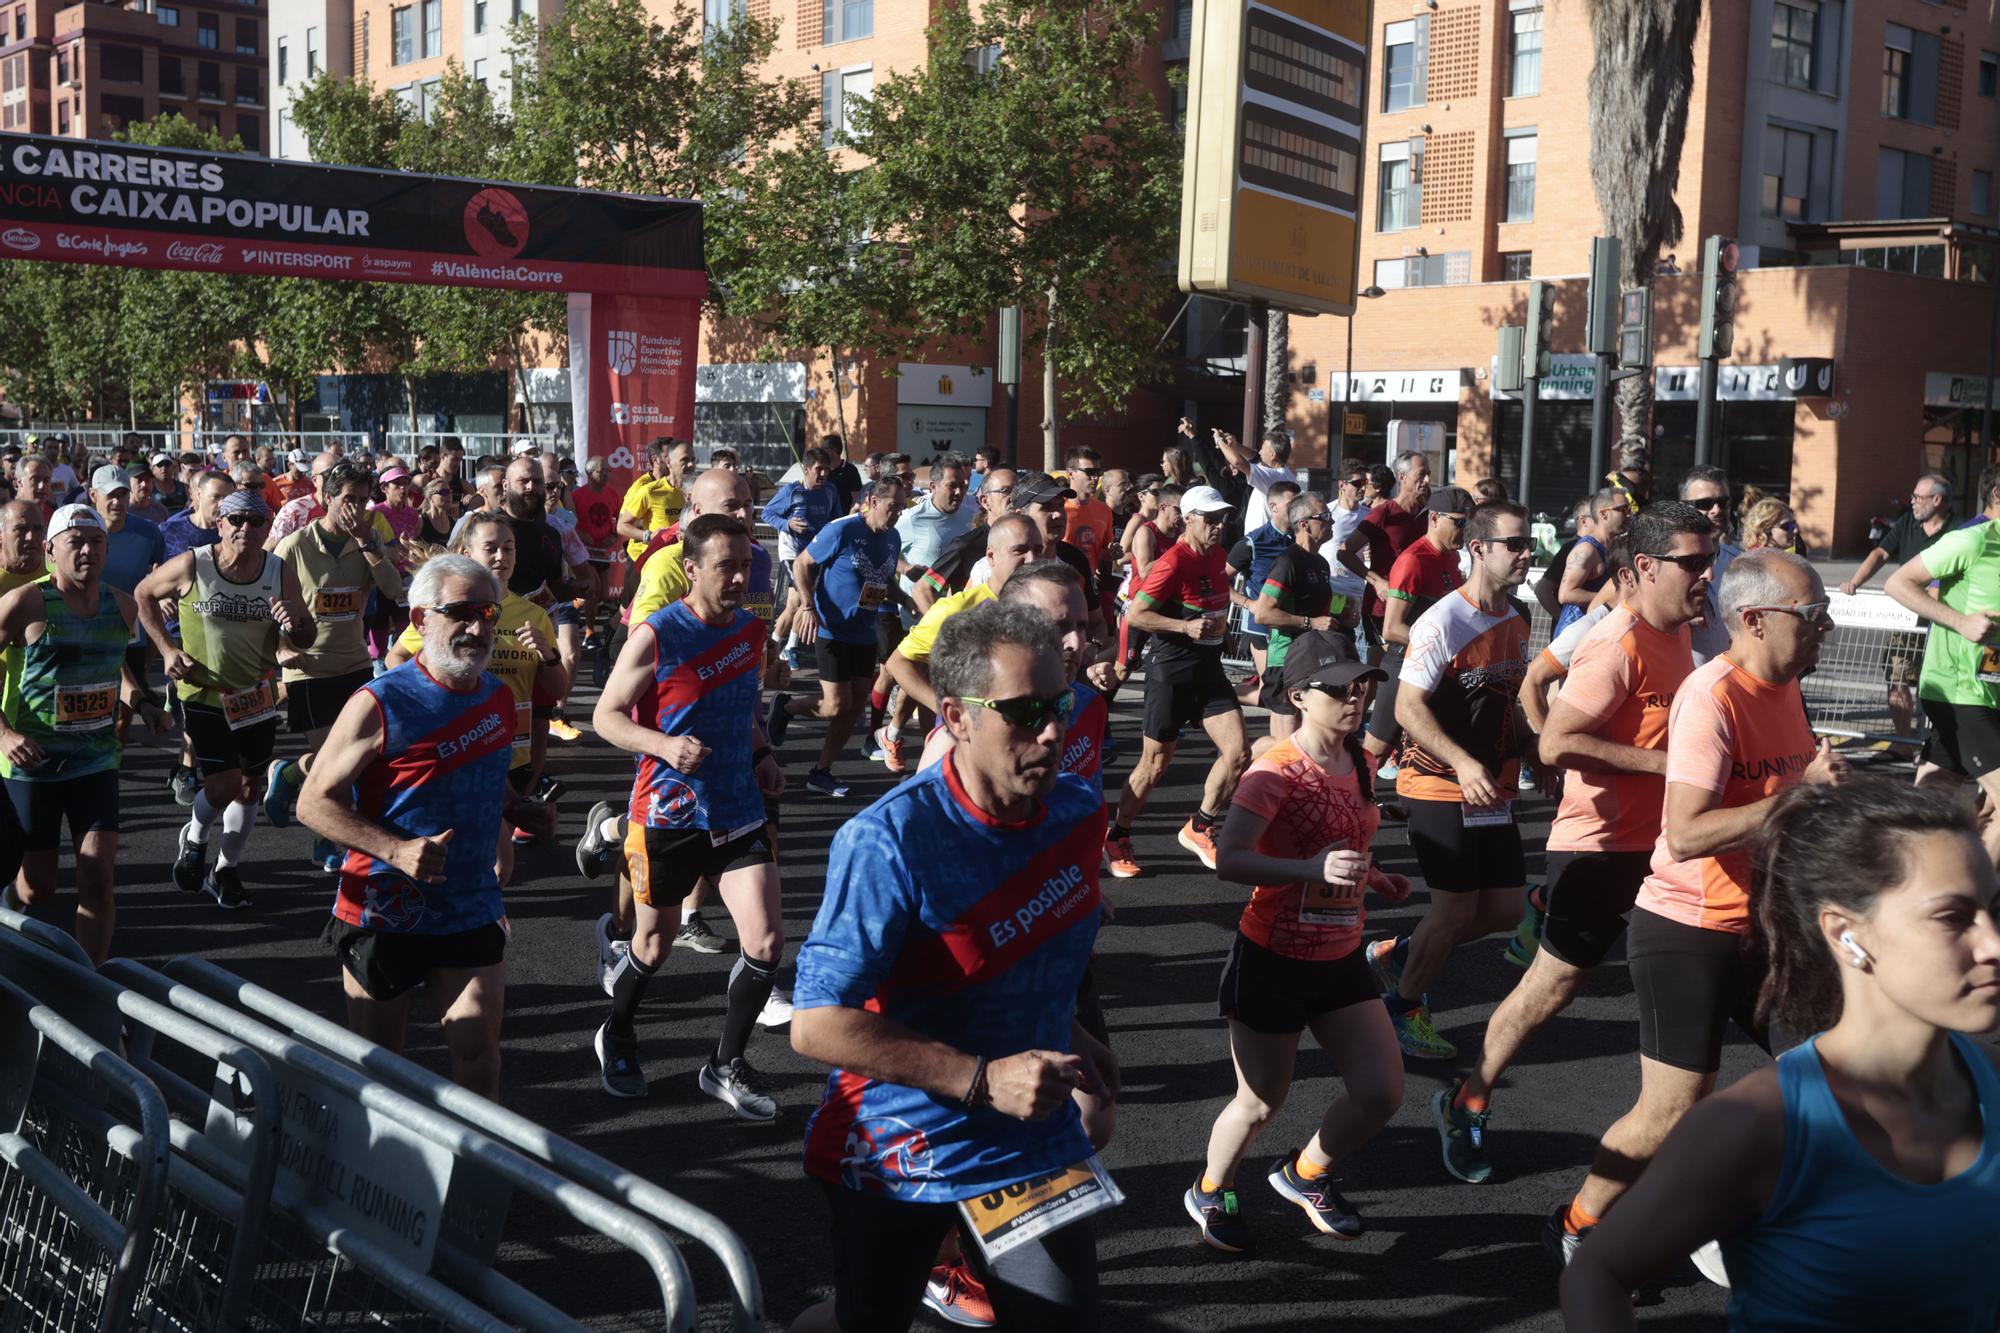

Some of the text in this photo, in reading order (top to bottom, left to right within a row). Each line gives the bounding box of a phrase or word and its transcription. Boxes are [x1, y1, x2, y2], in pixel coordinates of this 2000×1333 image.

[12, 144, 225, 192] CARRERES
[70, 184, 198, 223] CAIXA
[202, 197, 370, 237] POPULAR
[258, 250, 354, 270] INTERSPORT
[373, 258, 411, 270] aspaym
[431, 261, 564, 284] #ValènciaCorre
[640, 335, 681, 346] Fundació
[640, 346, 682, 356] Esportiva
[640, 356, 682, 366] Municipal
[1553, 363, 1596, 378] Urban
[1538, 377, 1594, 394] unning
[632, 404, 659, 415] caixa
[632, 413, 675, 425] popular
[323, 593, 352, 608] 3721
[697, 641, 752, 680] Es posible
[64, 692, 108, 713] 3525
[437, 713, 502, 759] Es posible
[988, 864, 1084, 949] Es posible
[1051, 882, 1091, 920] Valencia
[315, 1154, 346, 1201] DEL
